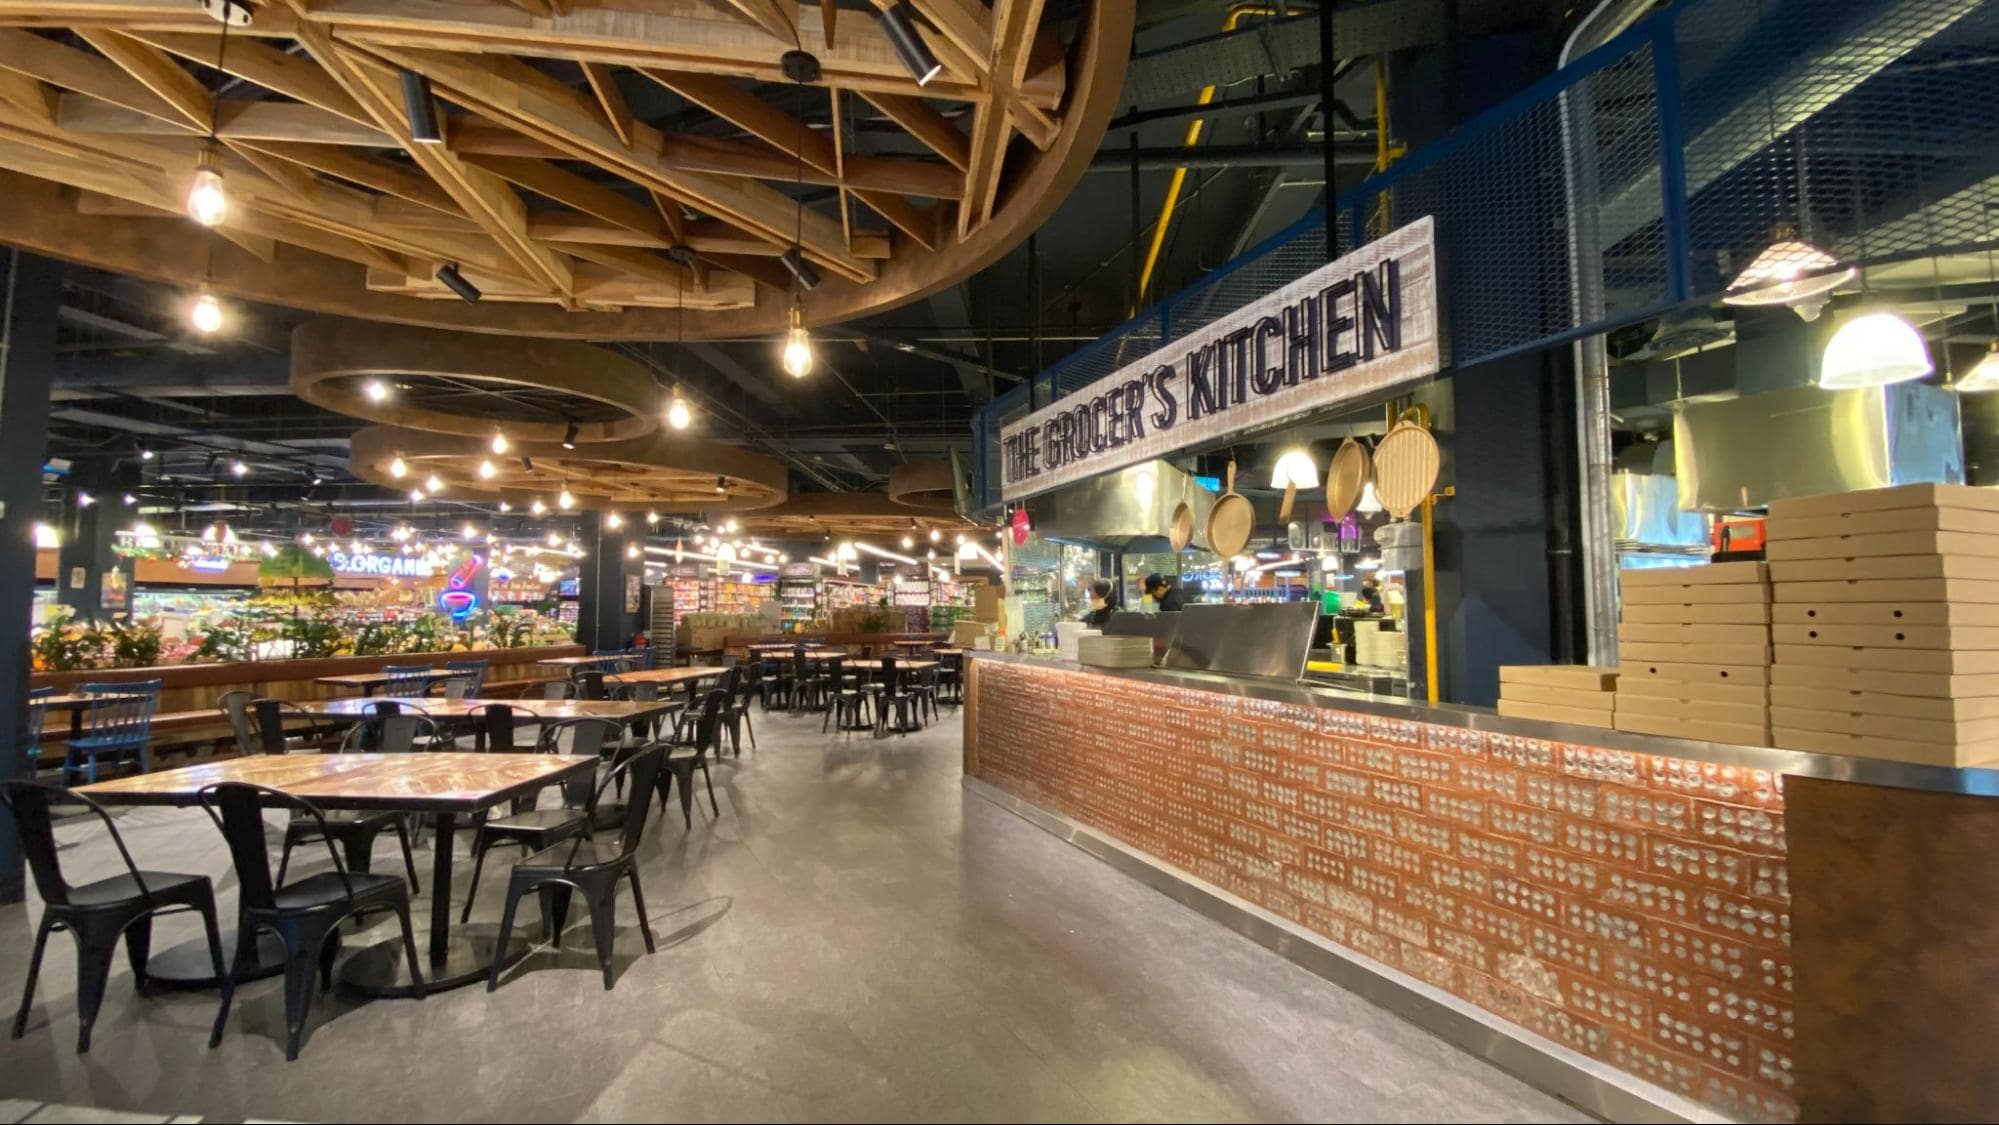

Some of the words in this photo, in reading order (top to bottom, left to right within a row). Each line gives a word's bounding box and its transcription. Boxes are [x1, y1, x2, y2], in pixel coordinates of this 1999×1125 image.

[1003, 426, 1040, 483] THE
[1043, 364, 1177, 470] GROCER'S
[1186, 258, 1398, 420] KITCHEN
